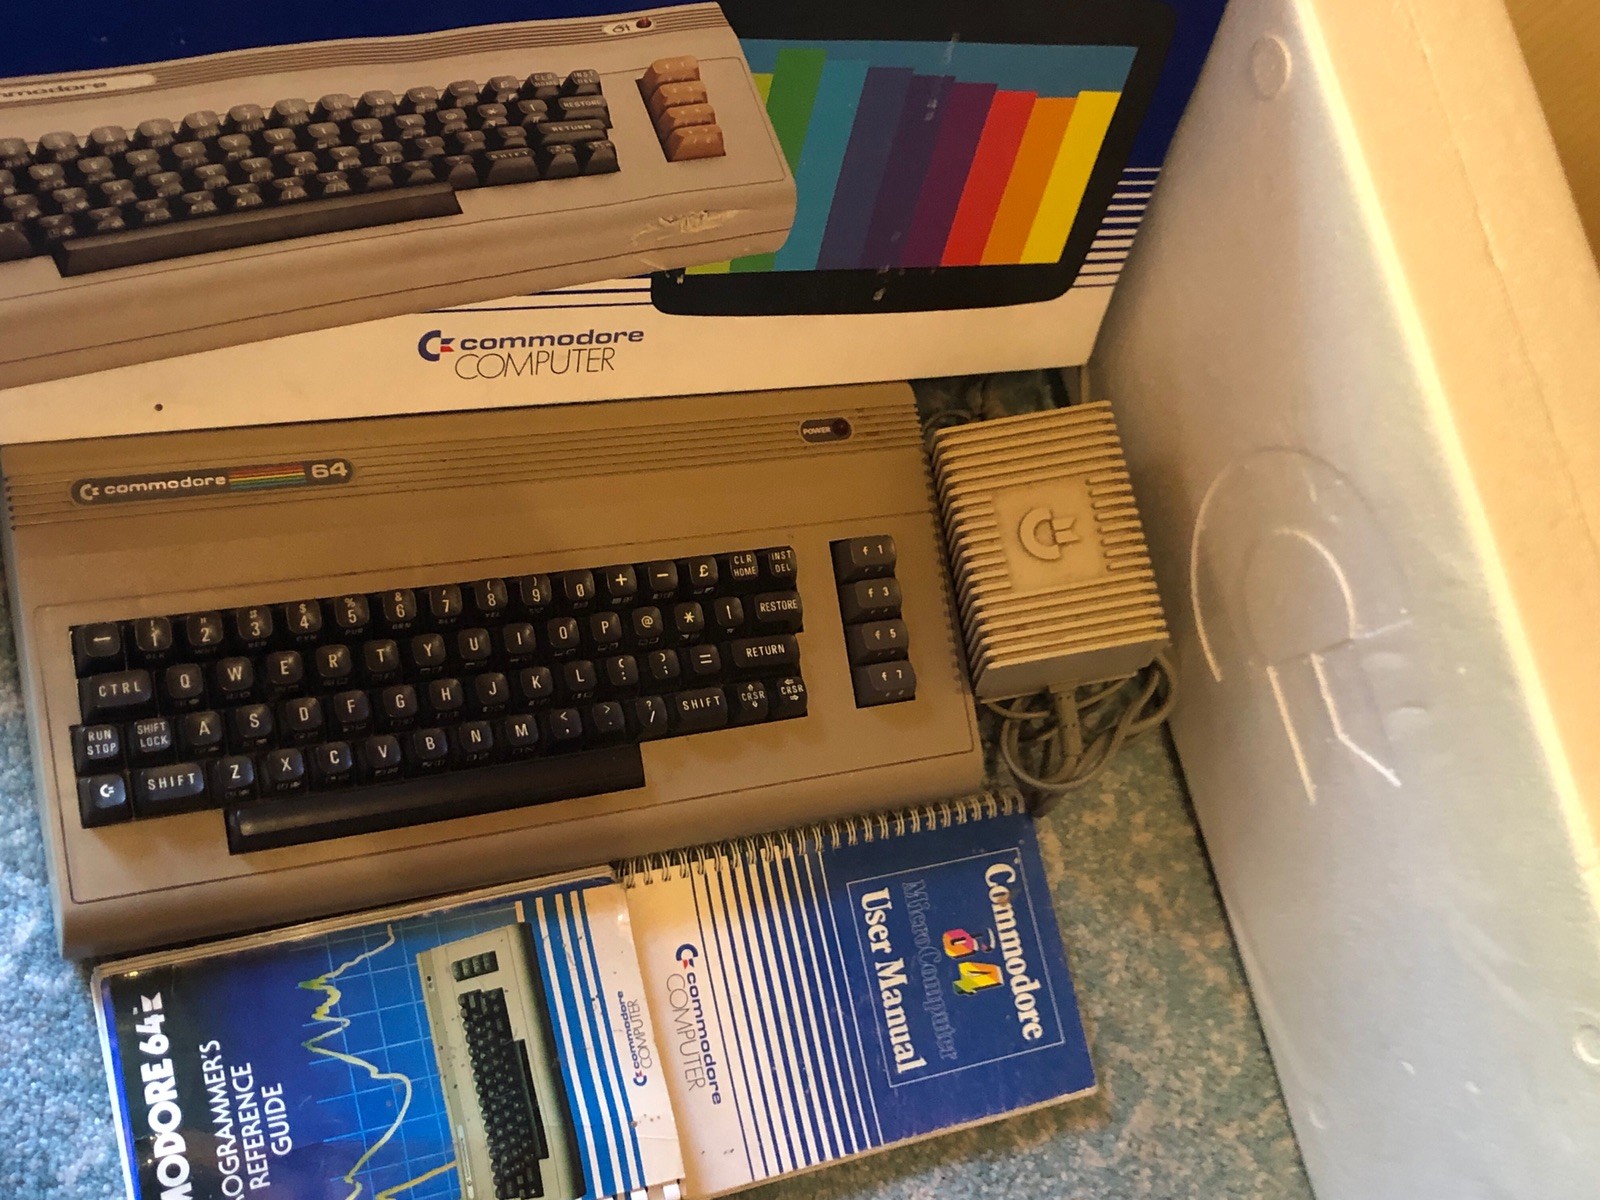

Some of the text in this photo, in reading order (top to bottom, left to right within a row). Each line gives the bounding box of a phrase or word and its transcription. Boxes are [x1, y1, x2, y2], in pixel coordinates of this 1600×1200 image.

[460, 329, 644, 350] commodore
[454, 347, 616, 380] COMPUTER
[802, 426, 832, 435] POWER
[104, 462, 348, 495] commodore 64
[734, 554, 752, 564] CLR
[771, 550, 792, 560] INST
[699, 564, 709, 578] £
[734, 566, 756, 577] HOME
[774, 563, 792, 572] DEL
[487, 593, 496, 607] 8
[532, 588, 541, 602] 9
[396, 604, 405, 618] 6
[442, 600, 450, 612] 7
[760, 600, 798, 612] RESTORE
[300, 616, 309, 630] 4
[348, 610, 357, 624] 5
[640, 615, 654, 628] @
[250, 621, 261, 636] 3
[559, 626, 568, 640] O
[601, 620, 610, 634] P
[200, 628, 210, 642] 2
[422, 642, 432, 657] Y
[469, 637, 479, 651] U
[746, 643, 785, 659] RETURN
[328, 654, 338, 668] R
[376, 648, 385, 662] T
[226, 666, 243, 682] W
[280, 660, 291, 675] E
[179, 674, 191, 689] Q
[531, 676, 542, 689] K
[575, 669, 586, 682] L
[98, 680, 142, 698] CTRL
[441, 687, 452, 701] H
[488, 682, 497, 696] J
[741, 690, 766, 702] CRSR
[780, 684, 804, 695] CRSR
[347, 699, 356, 714] F
[395, 694, 406, 708] G
[682, 696, 720, 711] SHIFT
[248, 713, 261, 728] S
[298, 706, 309, 722] D
[136, 722, 166, 735] SHIFT
[199, 721, 212, 736] A
[514, 724, 529, 737] M
[88, 730, 112, 742] RUN
[140, 735, 168, 748] LOCK
[425, 736, 436, 750] B
[470, 730, 482, 743] N
[86, 742, 117, 756] STOP
[378, 744, 388, 758] V
[330, 750, 340, 764] C
[229, 764, 241, 779] Z
[280, 757, 292, 772] X
[147, 772, 196, 791] SHIFT
[984, 863, 1044, 1041] Commodore
[861, 887, 928, 1074] User Manual
[618, 990, 640, 1069] commodore
[627, 998, 653, 1070] COMPUTER
[666, 973, 706, 1092] COMPUTER
[687, 972, 722, 1105] commodore
[199, 1040, 245, 1200] OGRAMMER'S
[230, 1062, 271, 1190] REFERENCE
[261, 1083, 292, 1156] GUIDE
